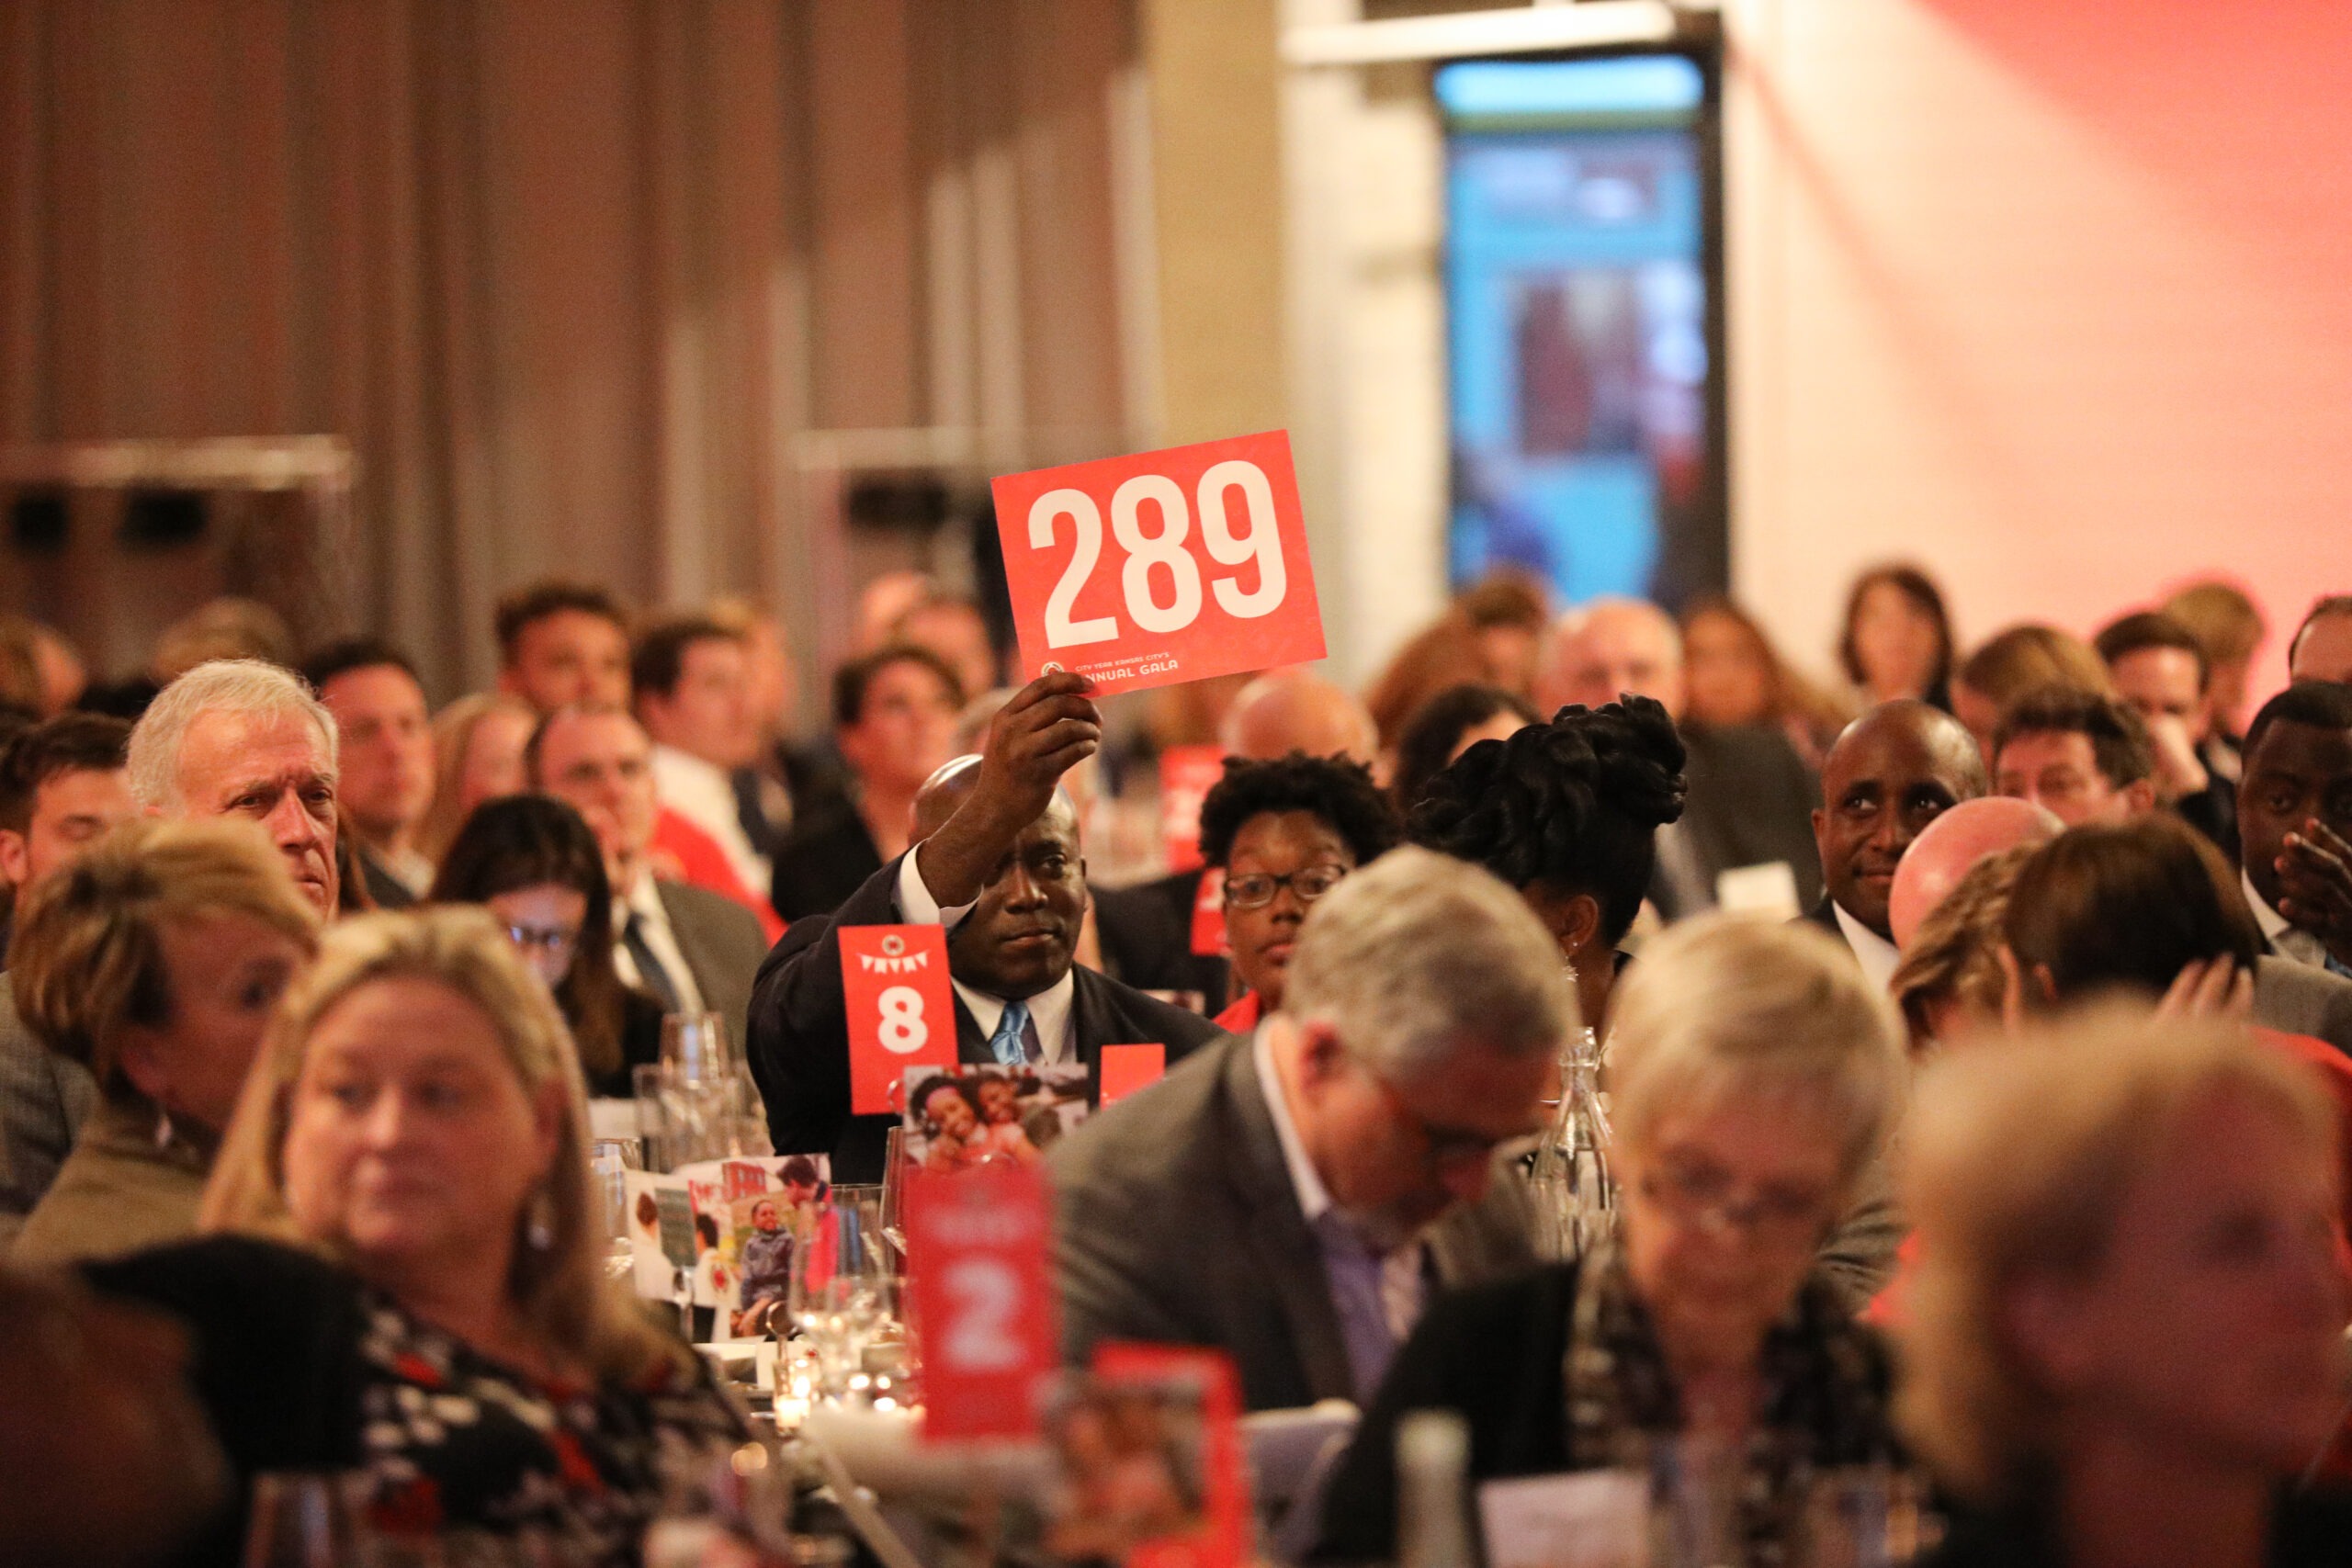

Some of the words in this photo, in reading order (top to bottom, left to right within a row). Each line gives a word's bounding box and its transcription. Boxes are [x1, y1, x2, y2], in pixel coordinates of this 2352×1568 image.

[1027, 459, 1287, 649] 289
[1085, 668, 1136, 682] NNUAL
[1139, 660, 1178, 675] GALA
[1114, 656, 1144, 666] KANSAS
[1146, 652, 1170, 660] CITY'S
[877, 986, 928, 1054] 8
[941, 1258, 1025, 1371] 2
